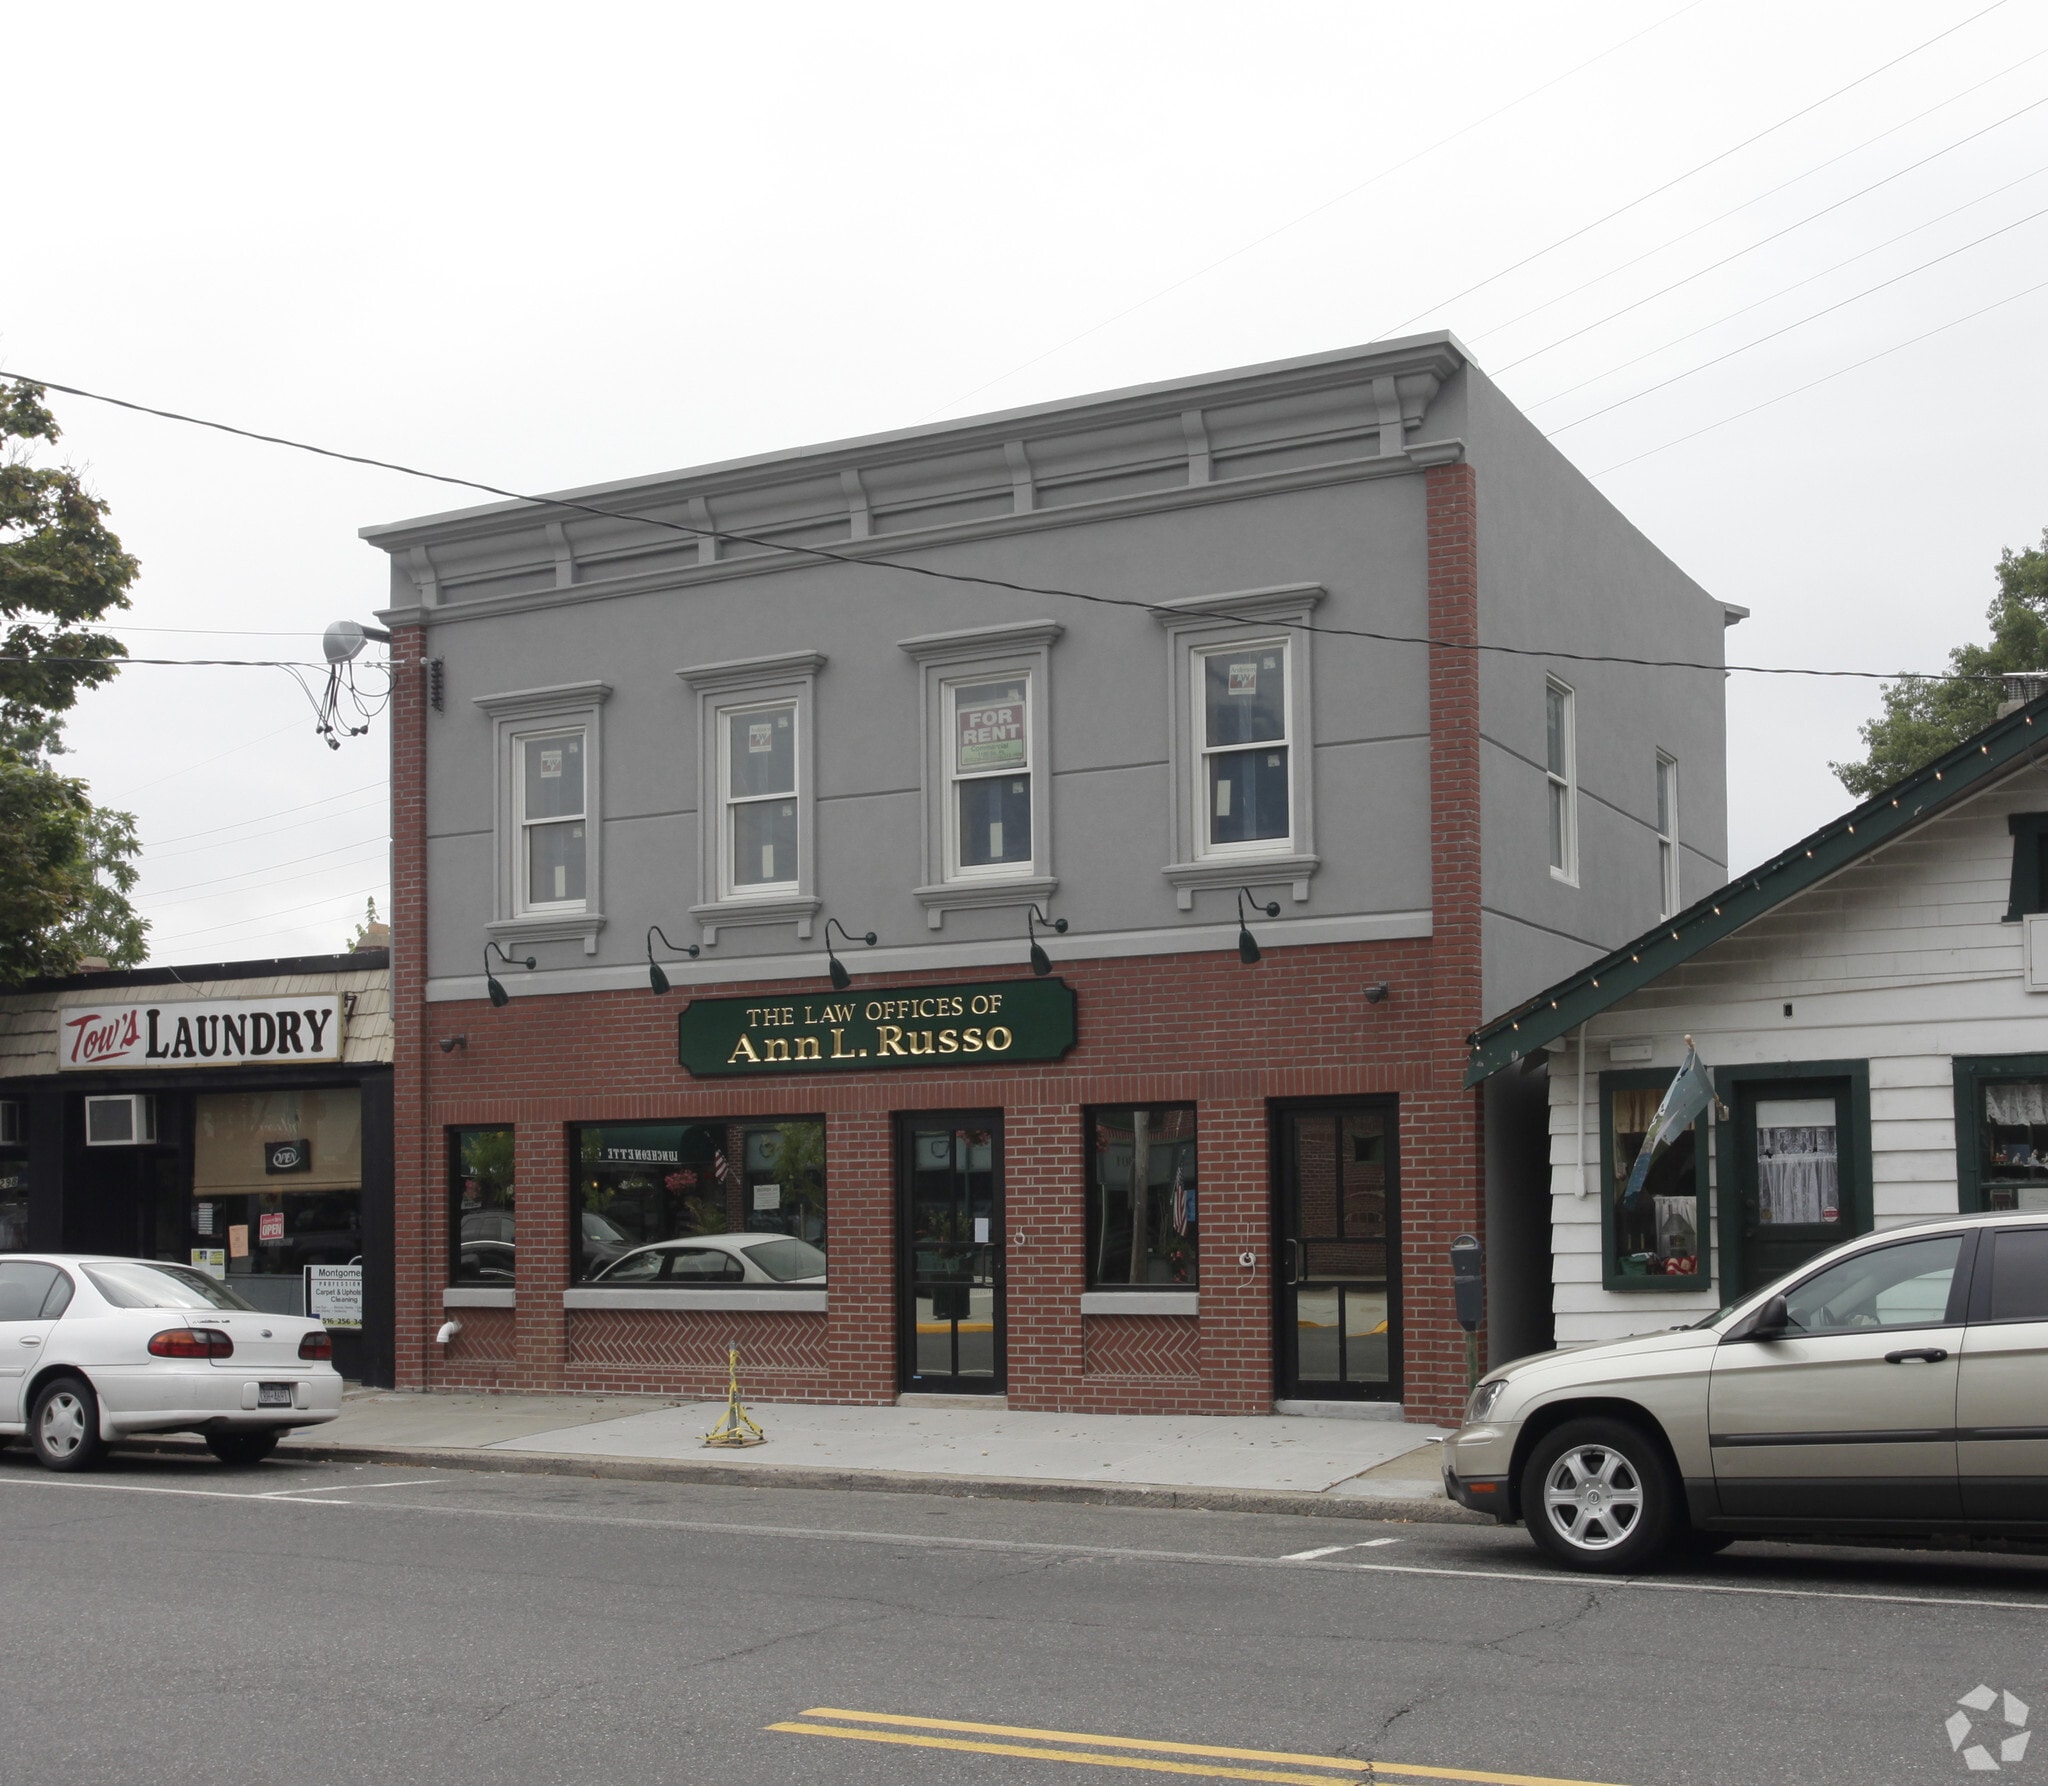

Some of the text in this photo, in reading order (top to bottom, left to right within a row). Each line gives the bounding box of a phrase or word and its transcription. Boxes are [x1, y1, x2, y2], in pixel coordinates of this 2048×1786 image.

[969, 709, 1012, 728] FOR
[963, 723, 1020, 745] RENT
[746, 994, 1002, 1027] THE LAW OFFICES OF
[145, 1008, 332, 1059] LAUNDRY
[727, 1025, 1012, 1063] Ann L. Russo
[275, 1151, 297, 1164] OPEN
[262, 1223, 281, 1236] OPEN
[318, 1268, 362, 1278] Montgome
[316, 1288, 336, 1296] Carpet
